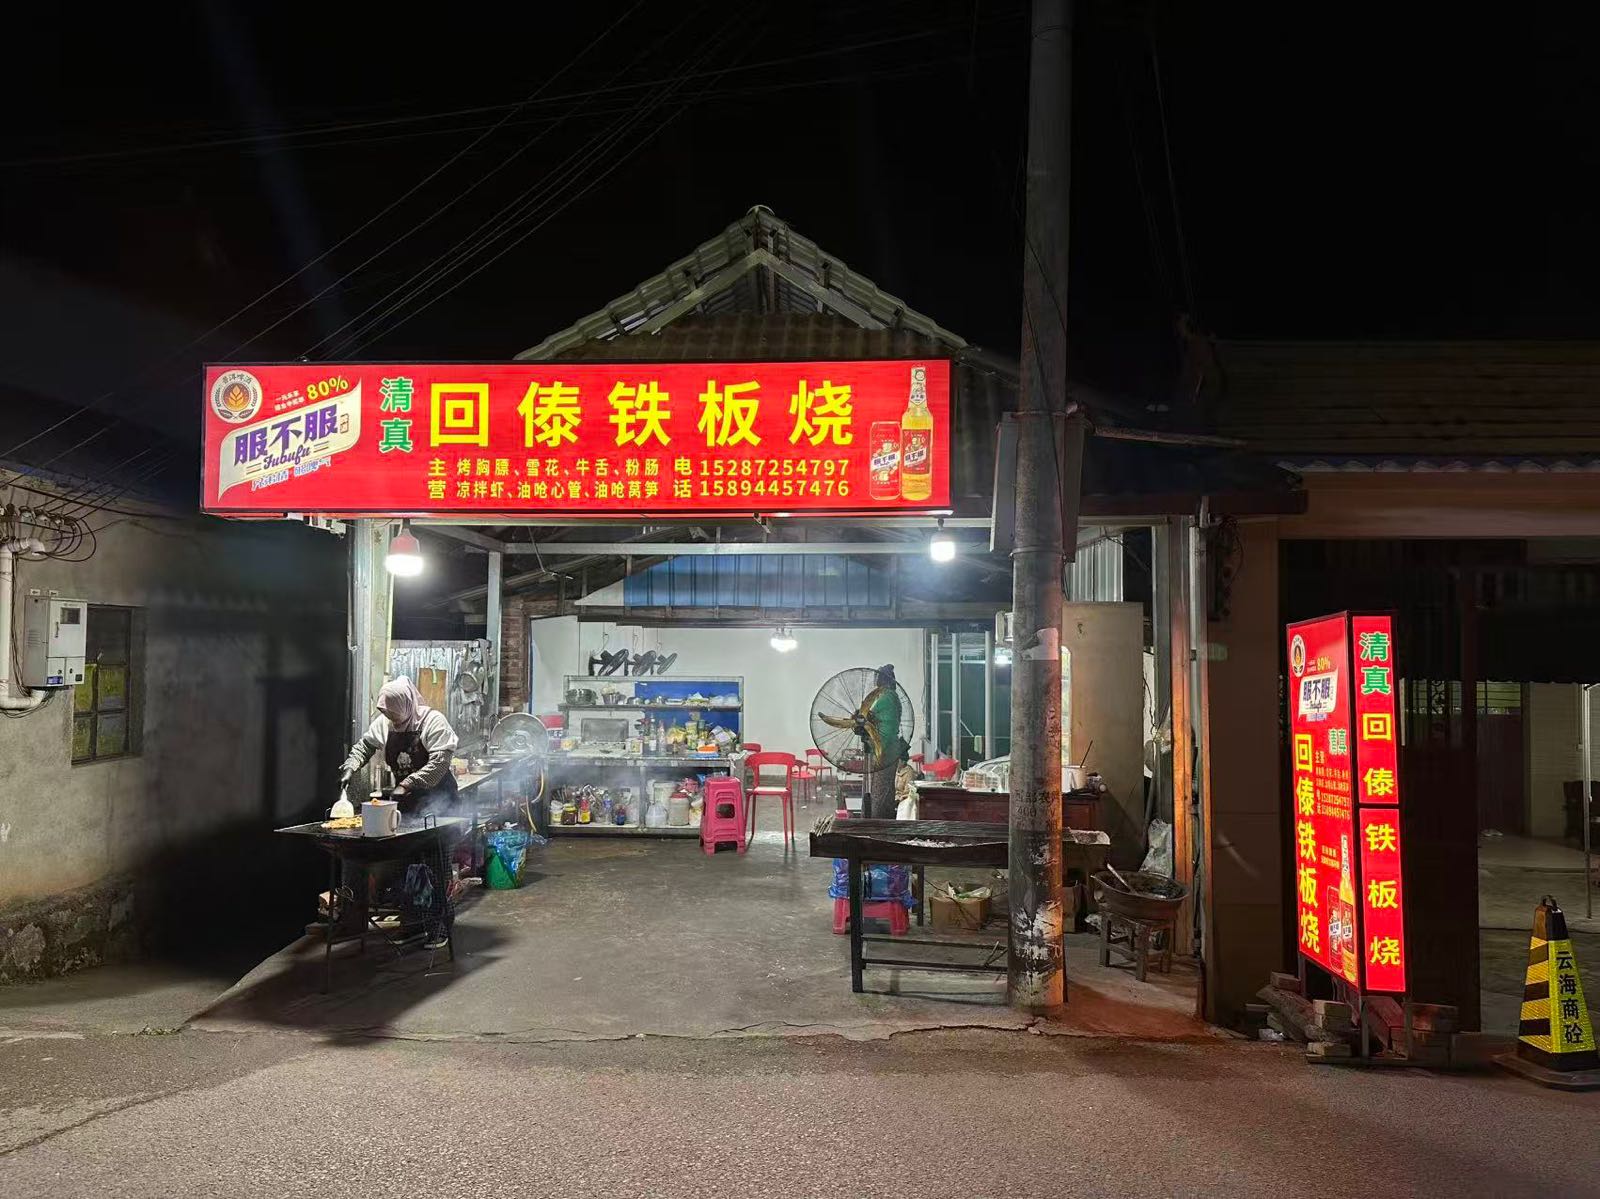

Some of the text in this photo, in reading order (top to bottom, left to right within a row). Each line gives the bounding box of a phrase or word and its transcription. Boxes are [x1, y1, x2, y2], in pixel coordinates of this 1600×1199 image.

[307, 375, 349, 401] 80%
[380, 377, 413, 453] 清真
[429, 379, 854, 448] 回傣铁板烧
[233, 403, 339, 467] 服不服
[263, 445, 312, 472] Fubufu
[428, 457, 448, 501] 主营
[674, 456, 693, 499] 电话
[700, 459, 850, 476] 15287254797
[700, 480, 850, 497] 15894457476
[1360, 631, 1392, 696] 清真
[1294, 733, 1322, 955] 回傣铁板烧
[1555, 950, 1584, 1045] 云海商砼
